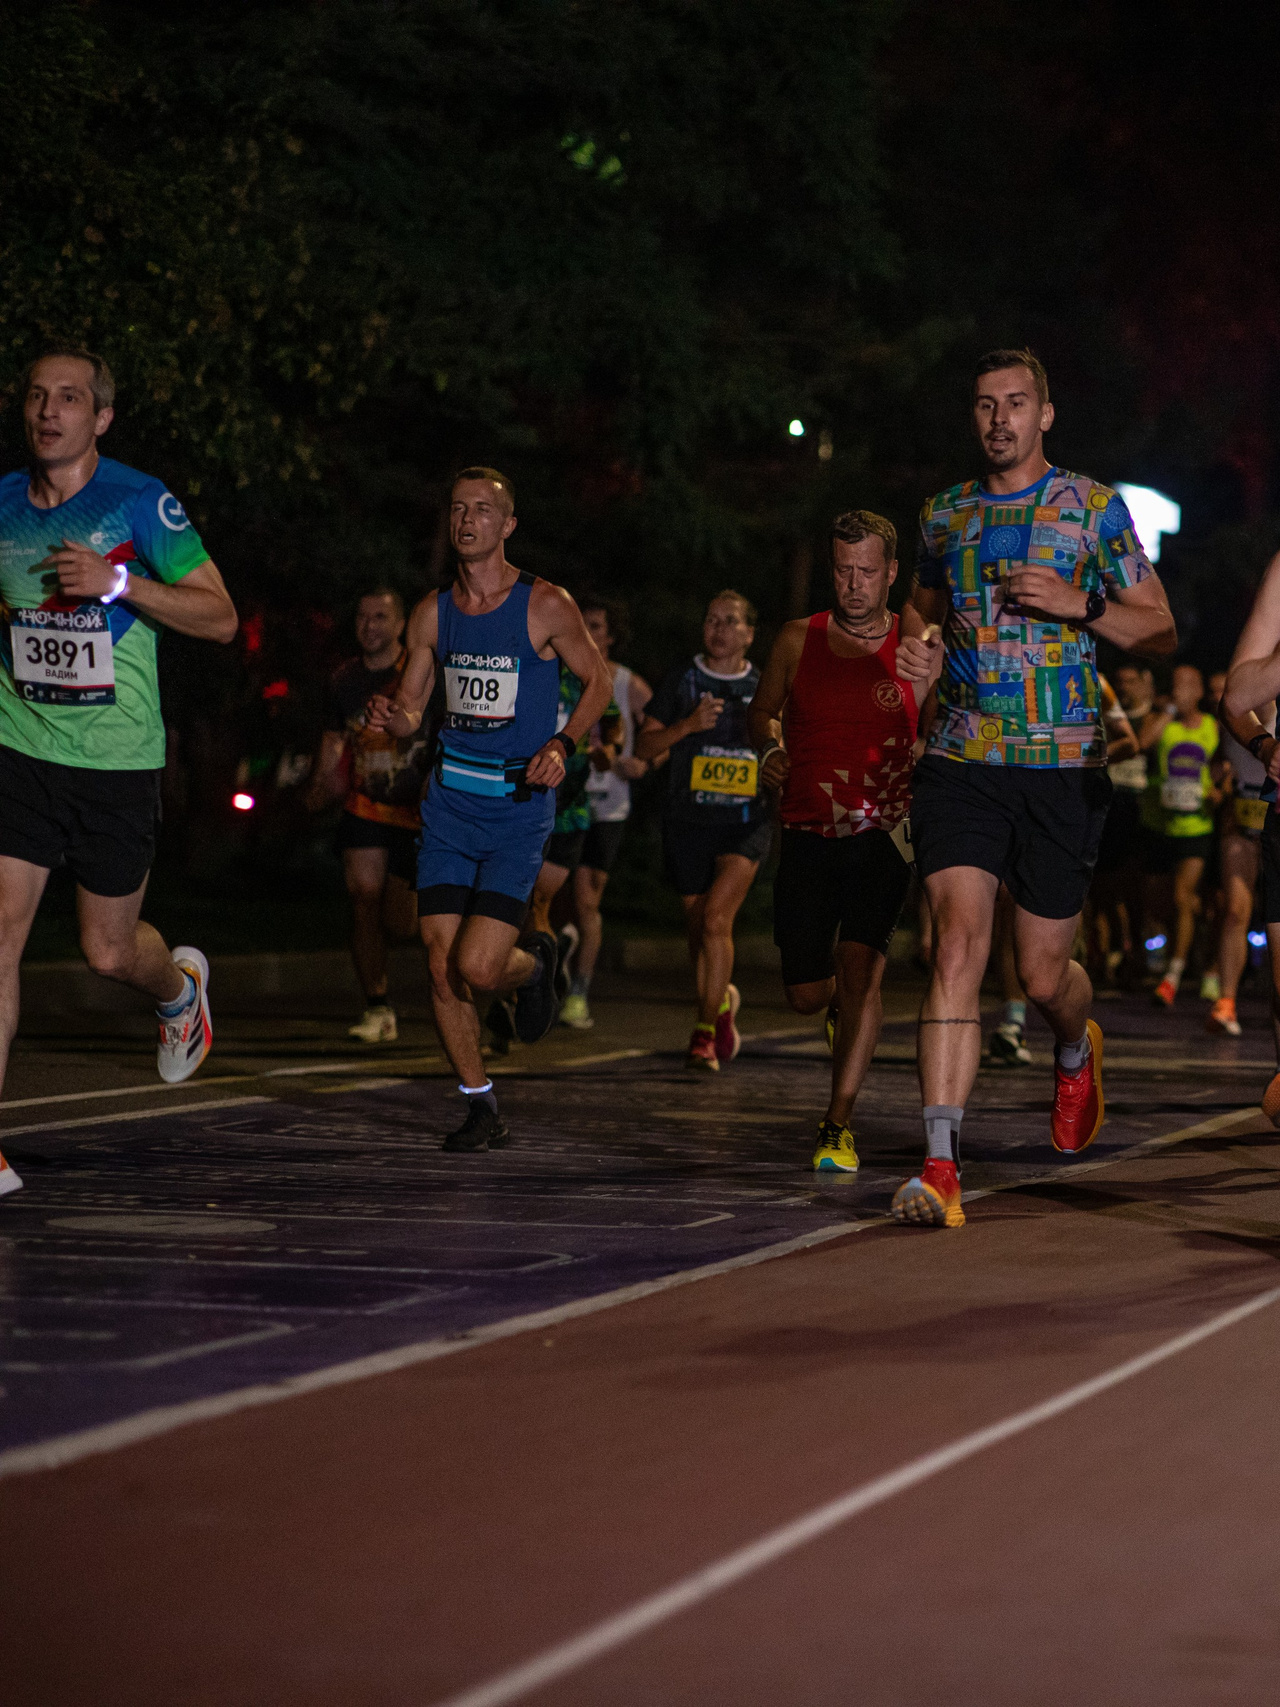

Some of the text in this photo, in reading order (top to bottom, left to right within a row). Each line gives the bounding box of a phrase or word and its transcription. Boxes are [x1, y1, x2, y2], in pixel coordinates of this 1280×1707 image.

[18, 608, 103, 628] НОЧНОЙ
[25, 636, 95, 668] 3891
[451, 652, 513, 669] НОЧНОЙ
[45, 668, 78, 680] ВАДИМ
[457, 675, 500, 702] 708
[462, 702, 490, 711] СЕРГЕЙ
[702, 761, 749, 784] 6093
